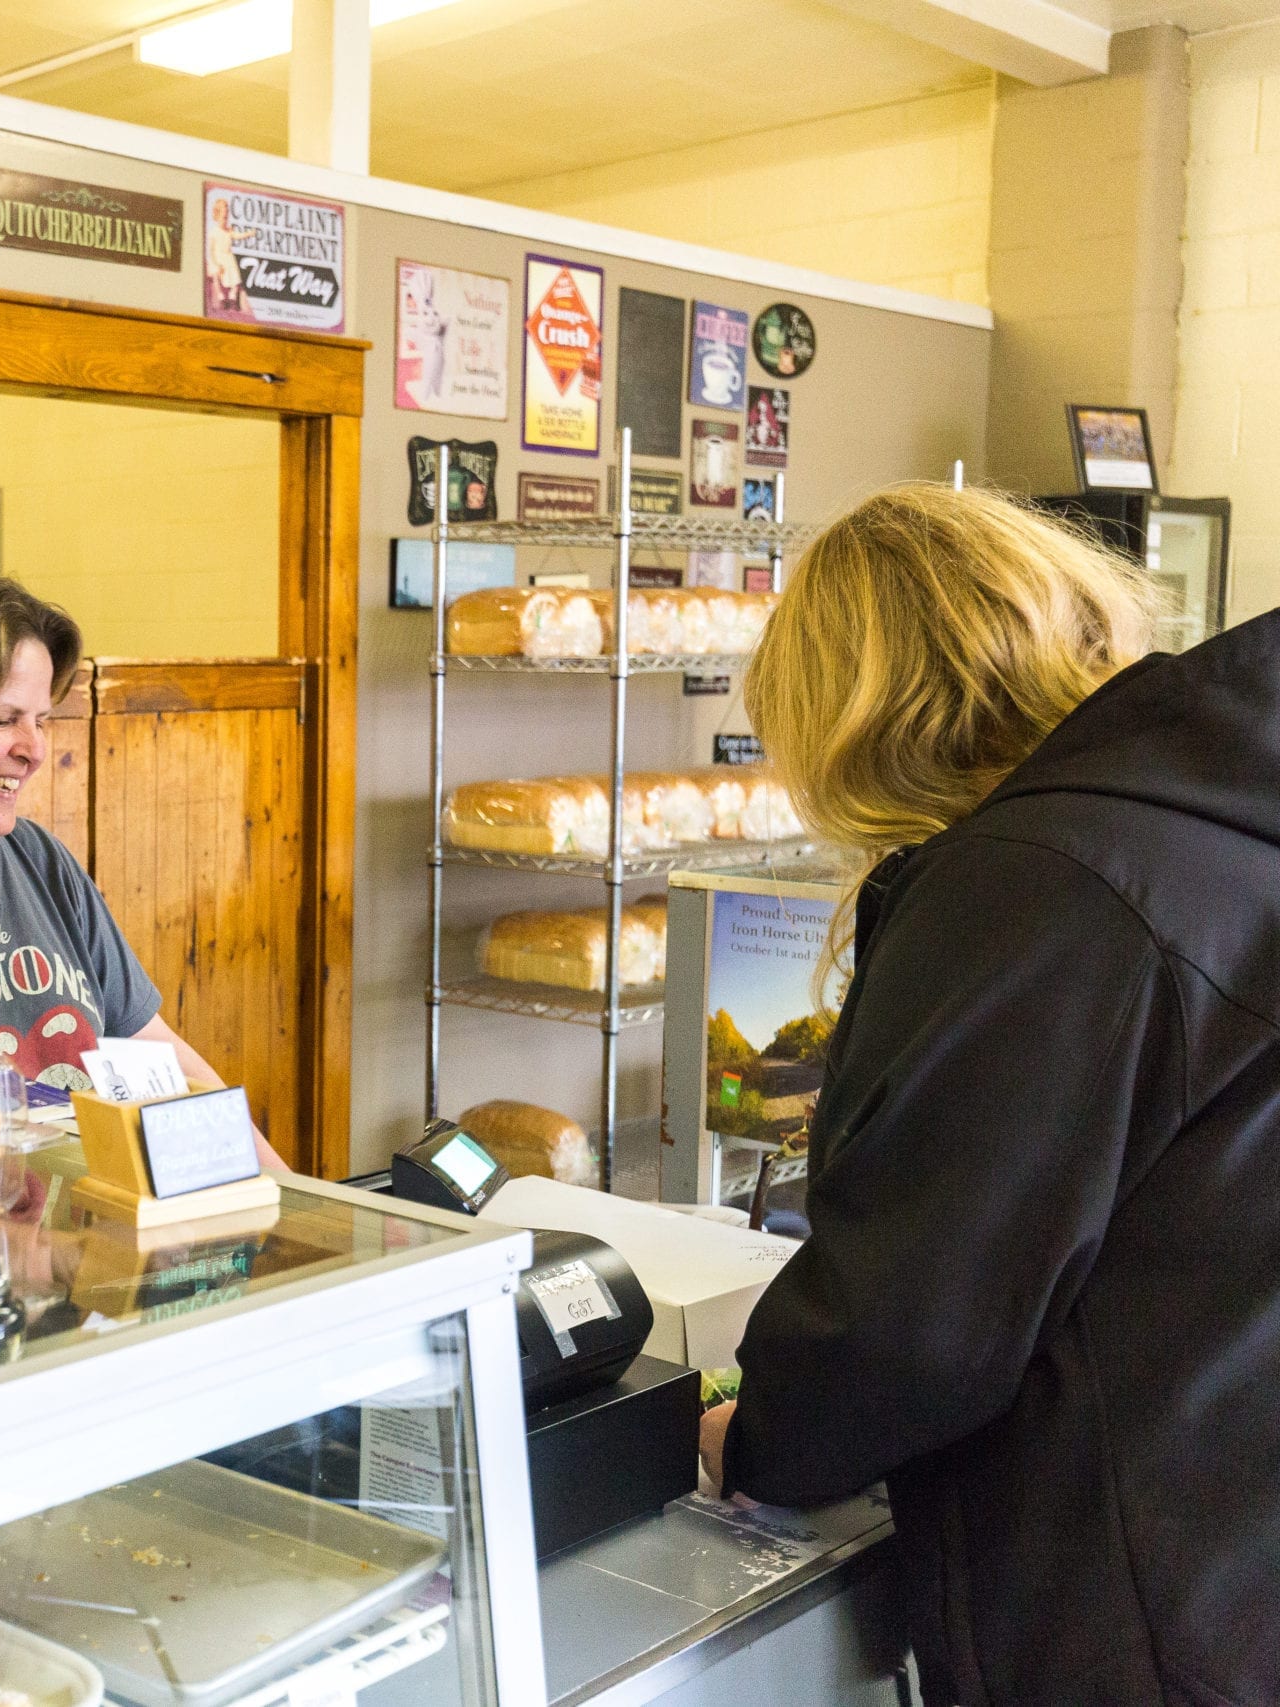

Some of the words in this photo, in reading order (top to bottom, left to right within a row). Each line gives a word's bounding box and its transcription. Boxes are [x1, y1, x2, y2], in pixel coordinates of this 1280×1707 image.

[230, 195, 338, 237] COMPLAINT
[231, 223, 338, 263] DEPARTMENT
[239, 256, 288, 292] That
[288, 265, 335, 306] Way
[537, 321, 591, 349] Crush
[741, 904, 781, 920] Proud
[783, 908, 831, 926] Sponso
[731, 922, 759, 937] Iron
[761, 925, 801, 941] Horse
[730, 942, 771, 956] October
[775, 946, 789, 958] 1st
[791, 949, 811, 961] and
[567, 1297, 595, 1320] GST
